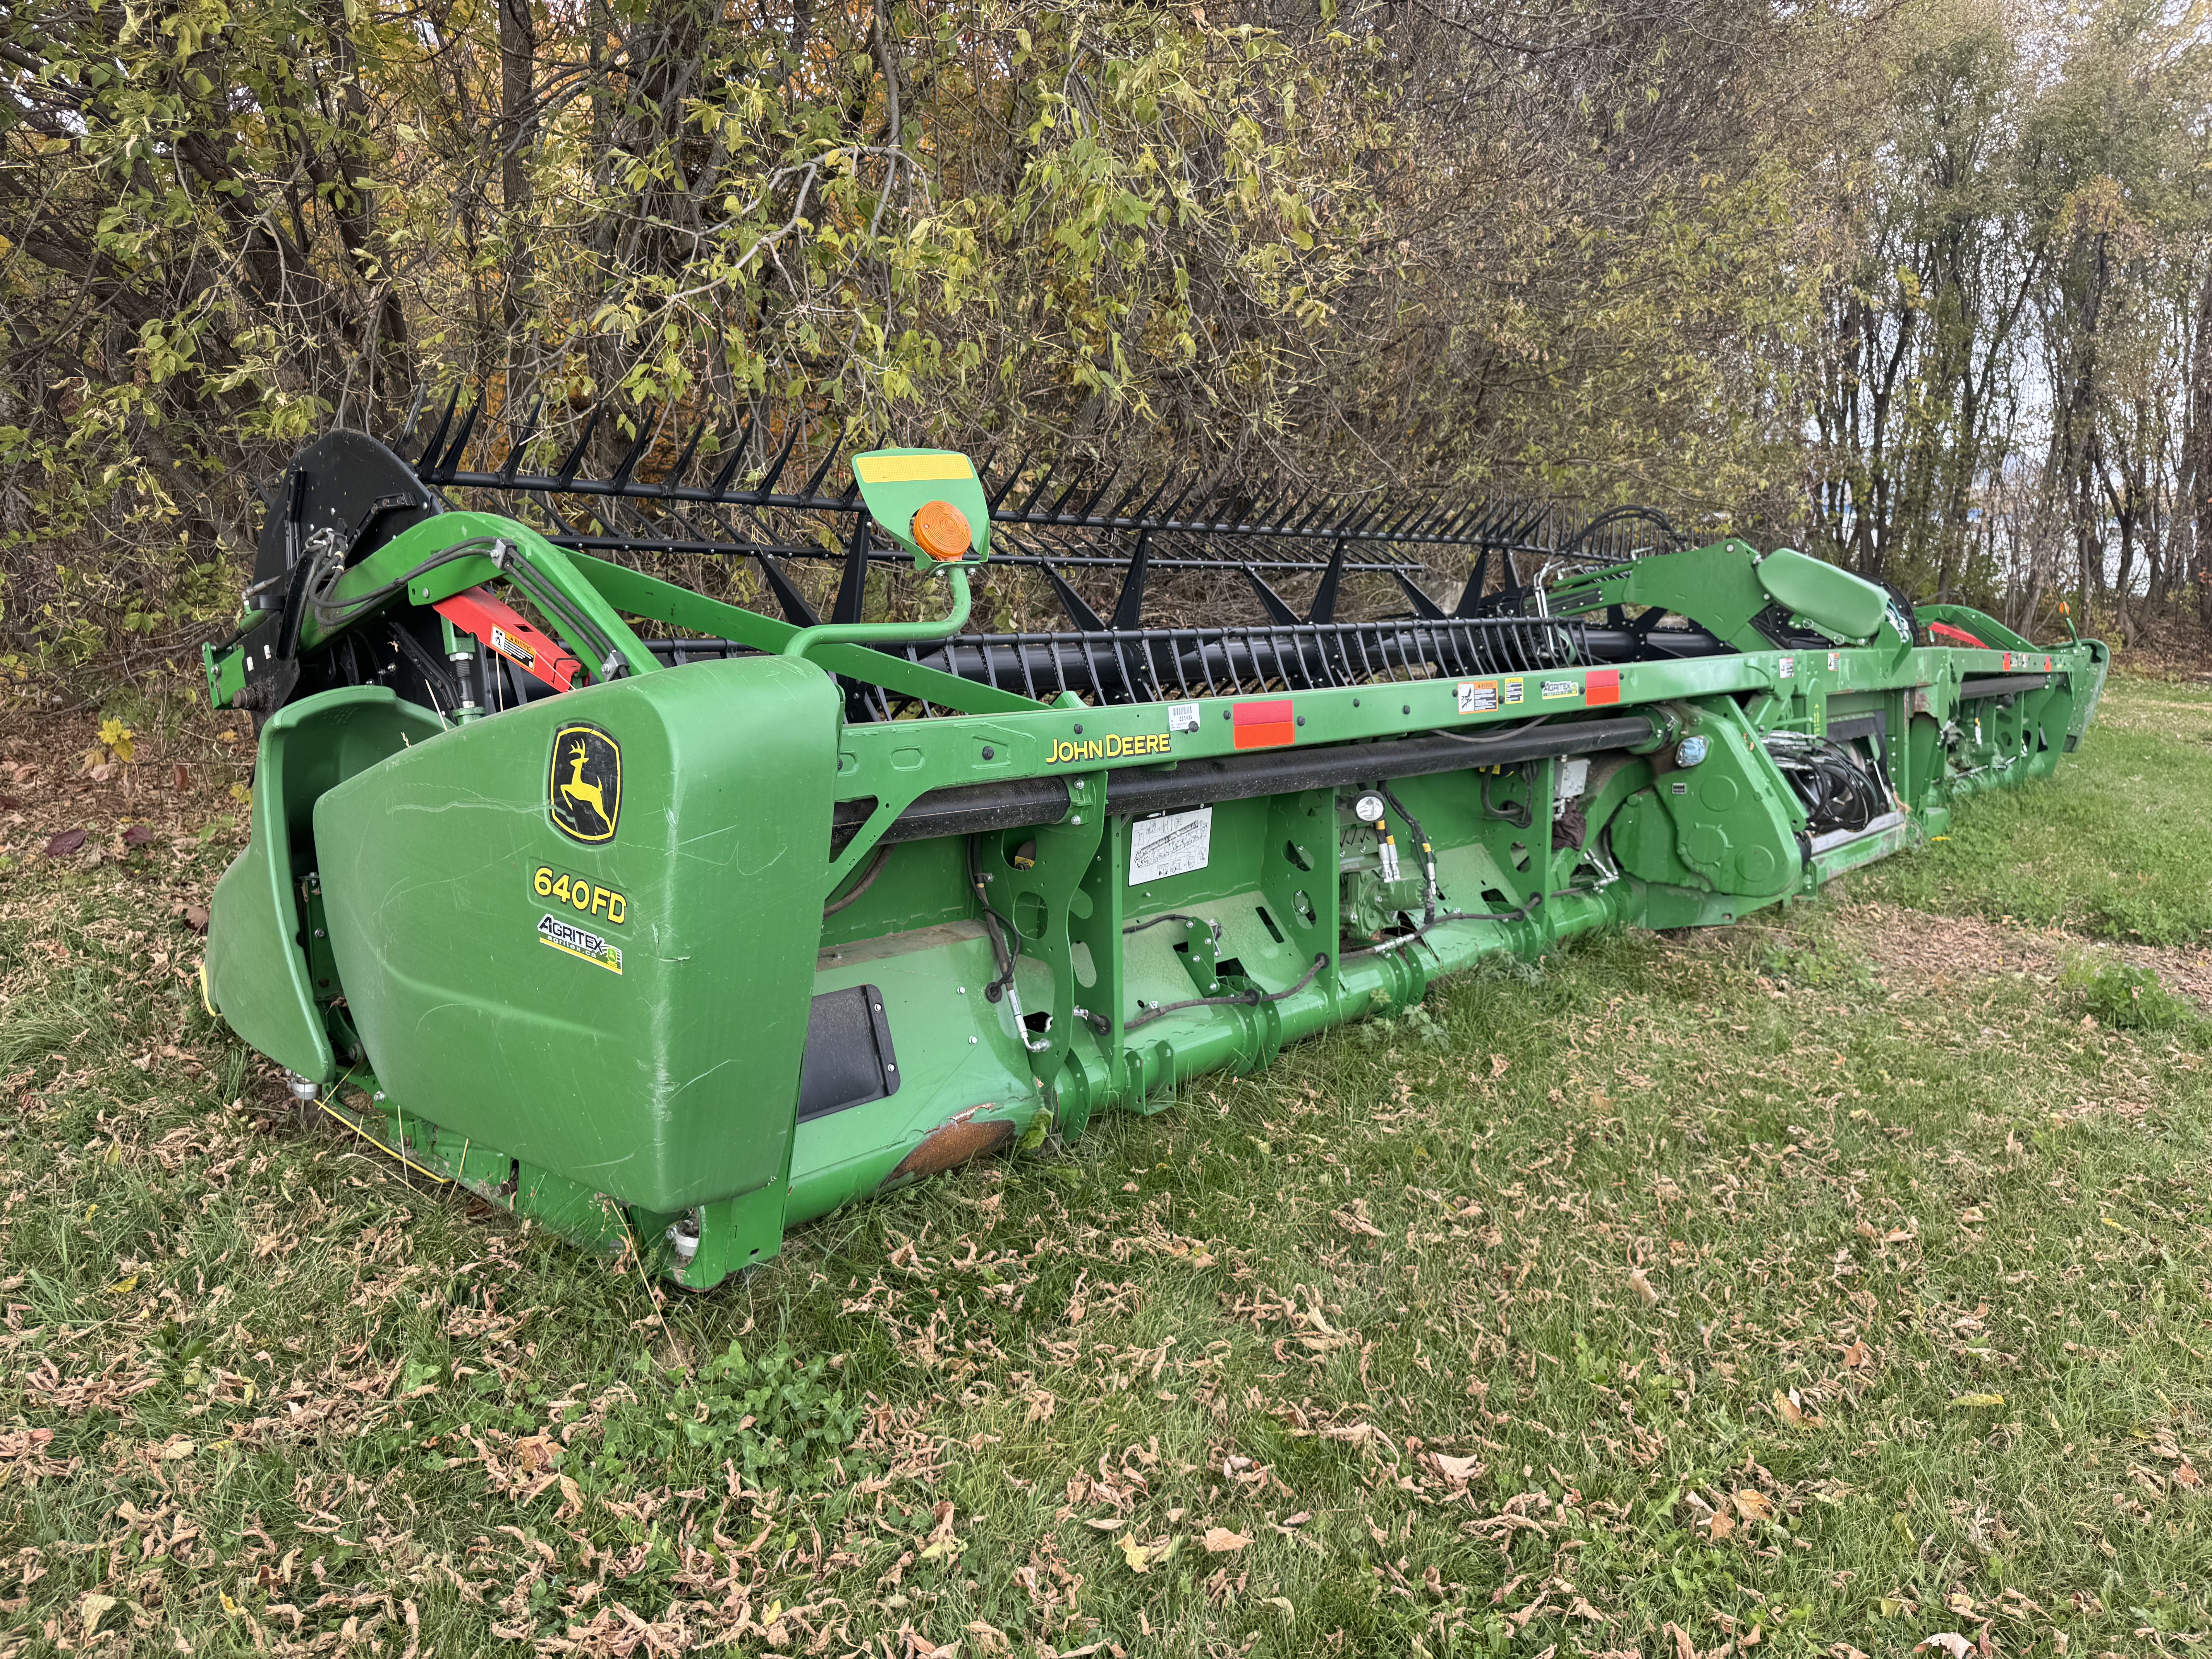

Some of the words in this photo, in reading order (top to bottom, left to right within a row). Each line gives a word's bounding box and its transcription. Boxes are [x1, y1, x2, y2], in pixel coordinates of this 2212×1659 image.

[514, 638, 531, 652] WARNING
[1543, 683, 1570, 692] AGRITEX
[1046, 738, 1103, 763] JOHN
[1106, 733, 1171, 757] DEERE
[533, 866, 627, 924] 640FD
[539, 916, 603, 953] AGRITEX
[547, 935, 597, 958] agritex.ca
